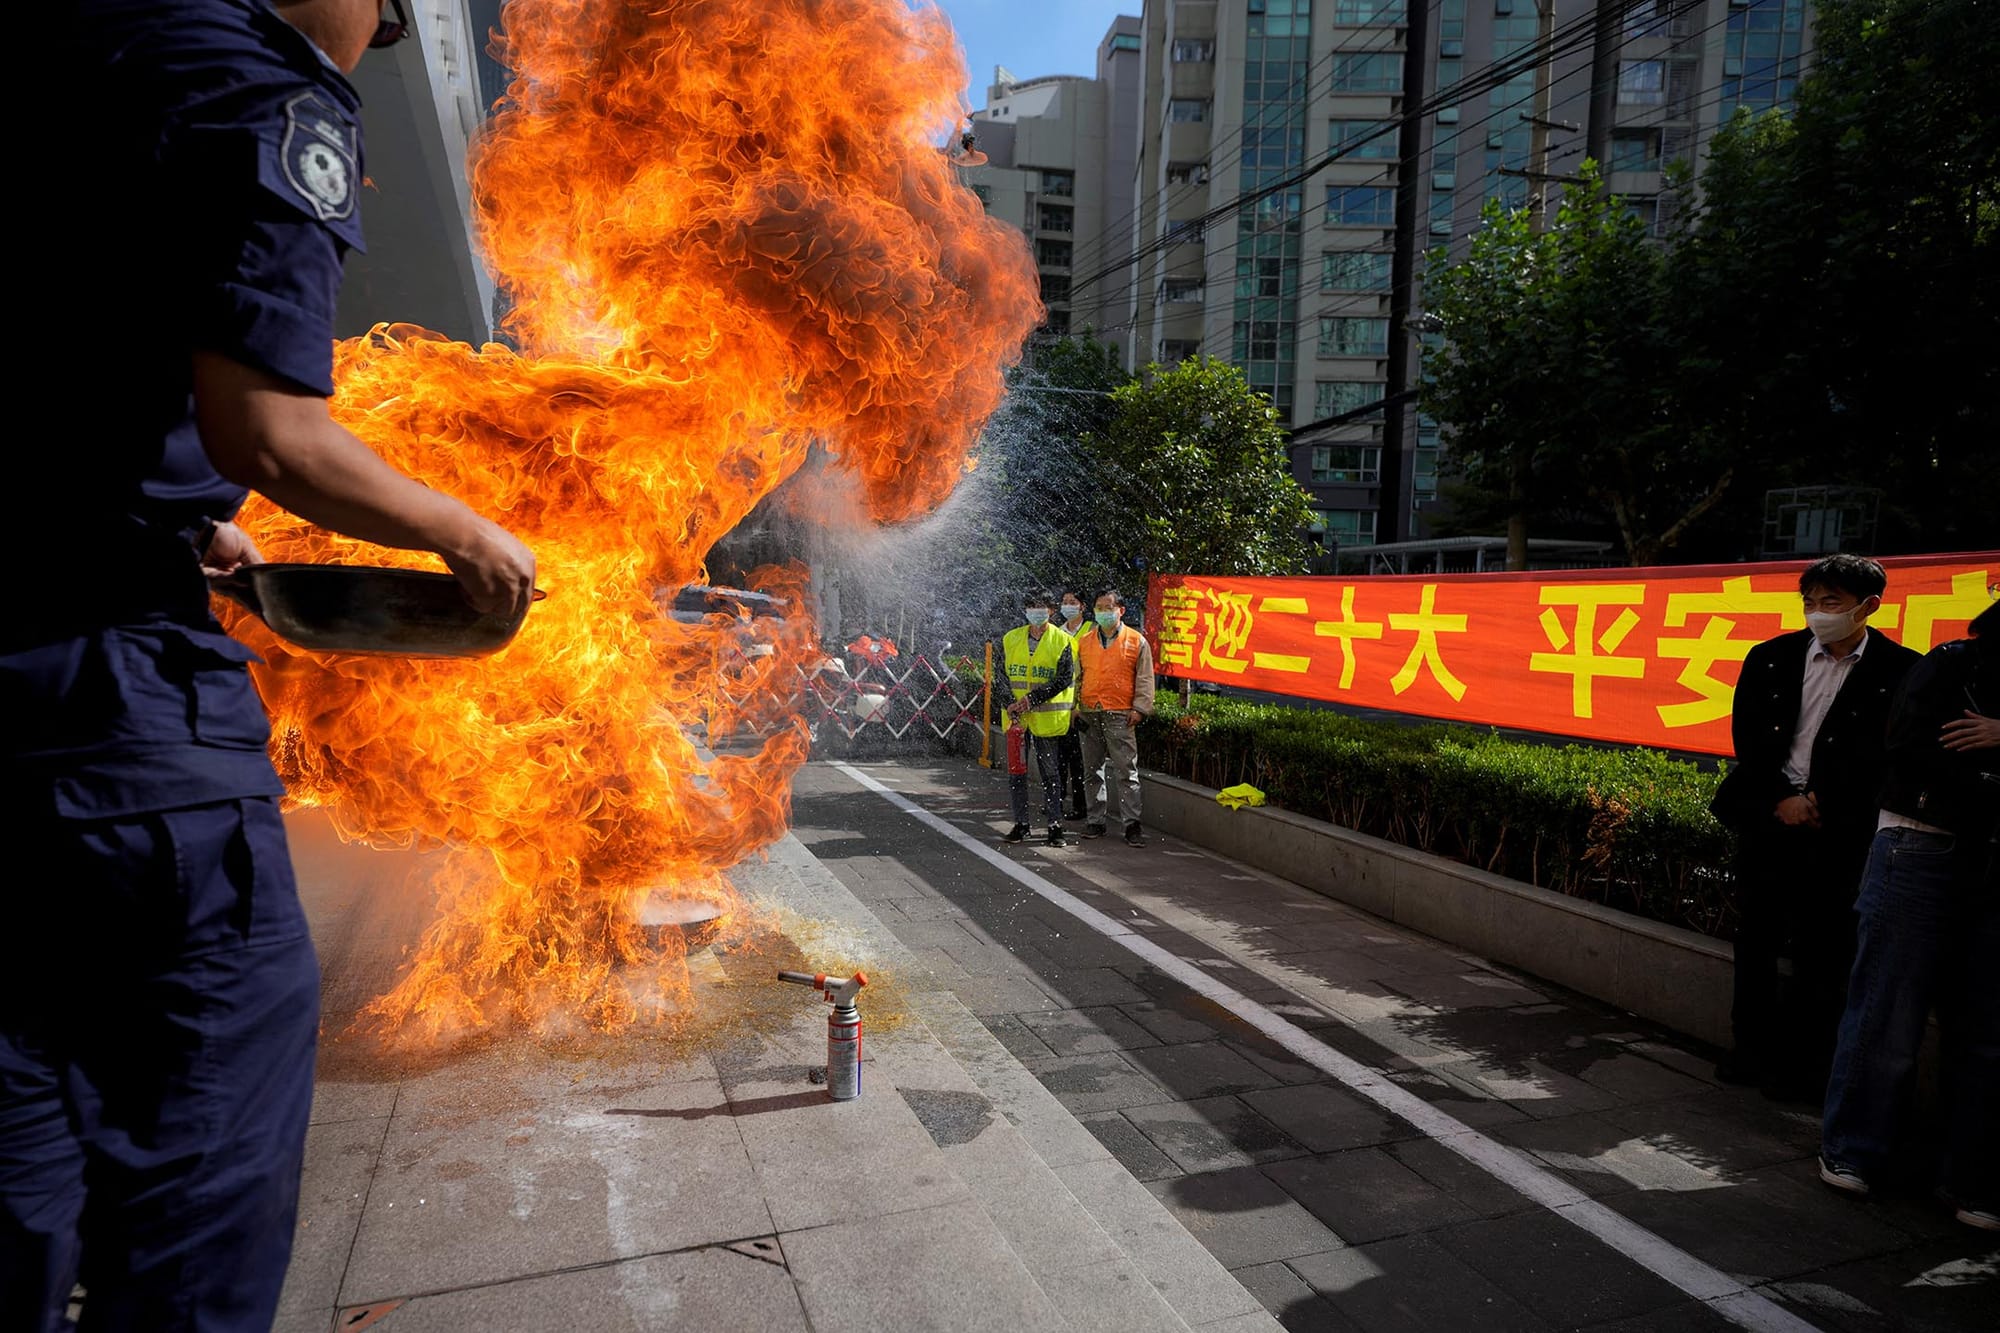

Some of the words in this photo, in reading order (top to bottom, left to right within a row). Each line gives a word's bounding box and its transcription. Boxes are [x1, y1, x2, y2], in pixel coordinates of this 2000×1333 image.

[1157, 584, 1468, 702] 喜迎二十大
